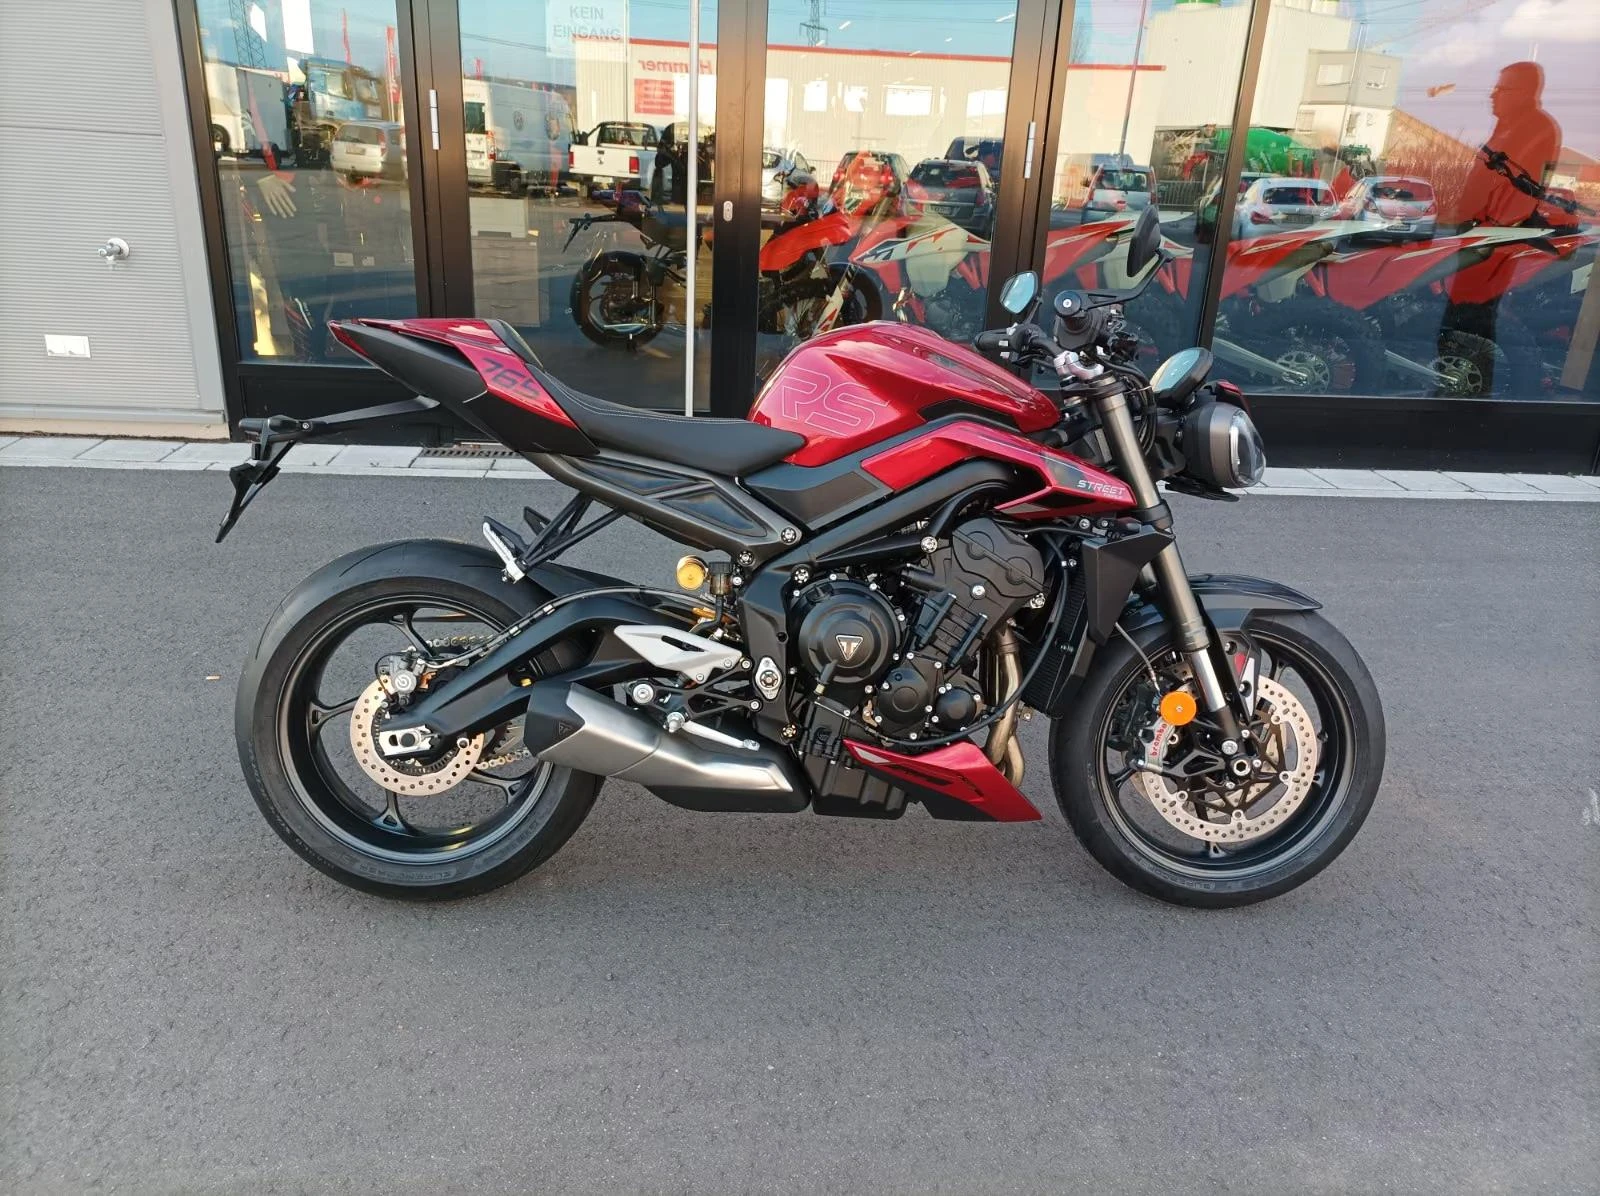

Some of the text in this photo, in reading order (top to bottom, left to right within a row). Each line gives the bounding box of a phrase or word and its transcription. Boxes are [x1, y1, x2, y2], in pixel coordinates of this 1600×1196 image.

[569, 4, 604, 20] KEIN
[552, 23, 622, 41] EINGANG
[482, 357, 541, 401] 765
[781, 364, 890, 437] RS
[1076, 479, 1126, 496] STREET
[1149, 723, 1168, 757] brembo
